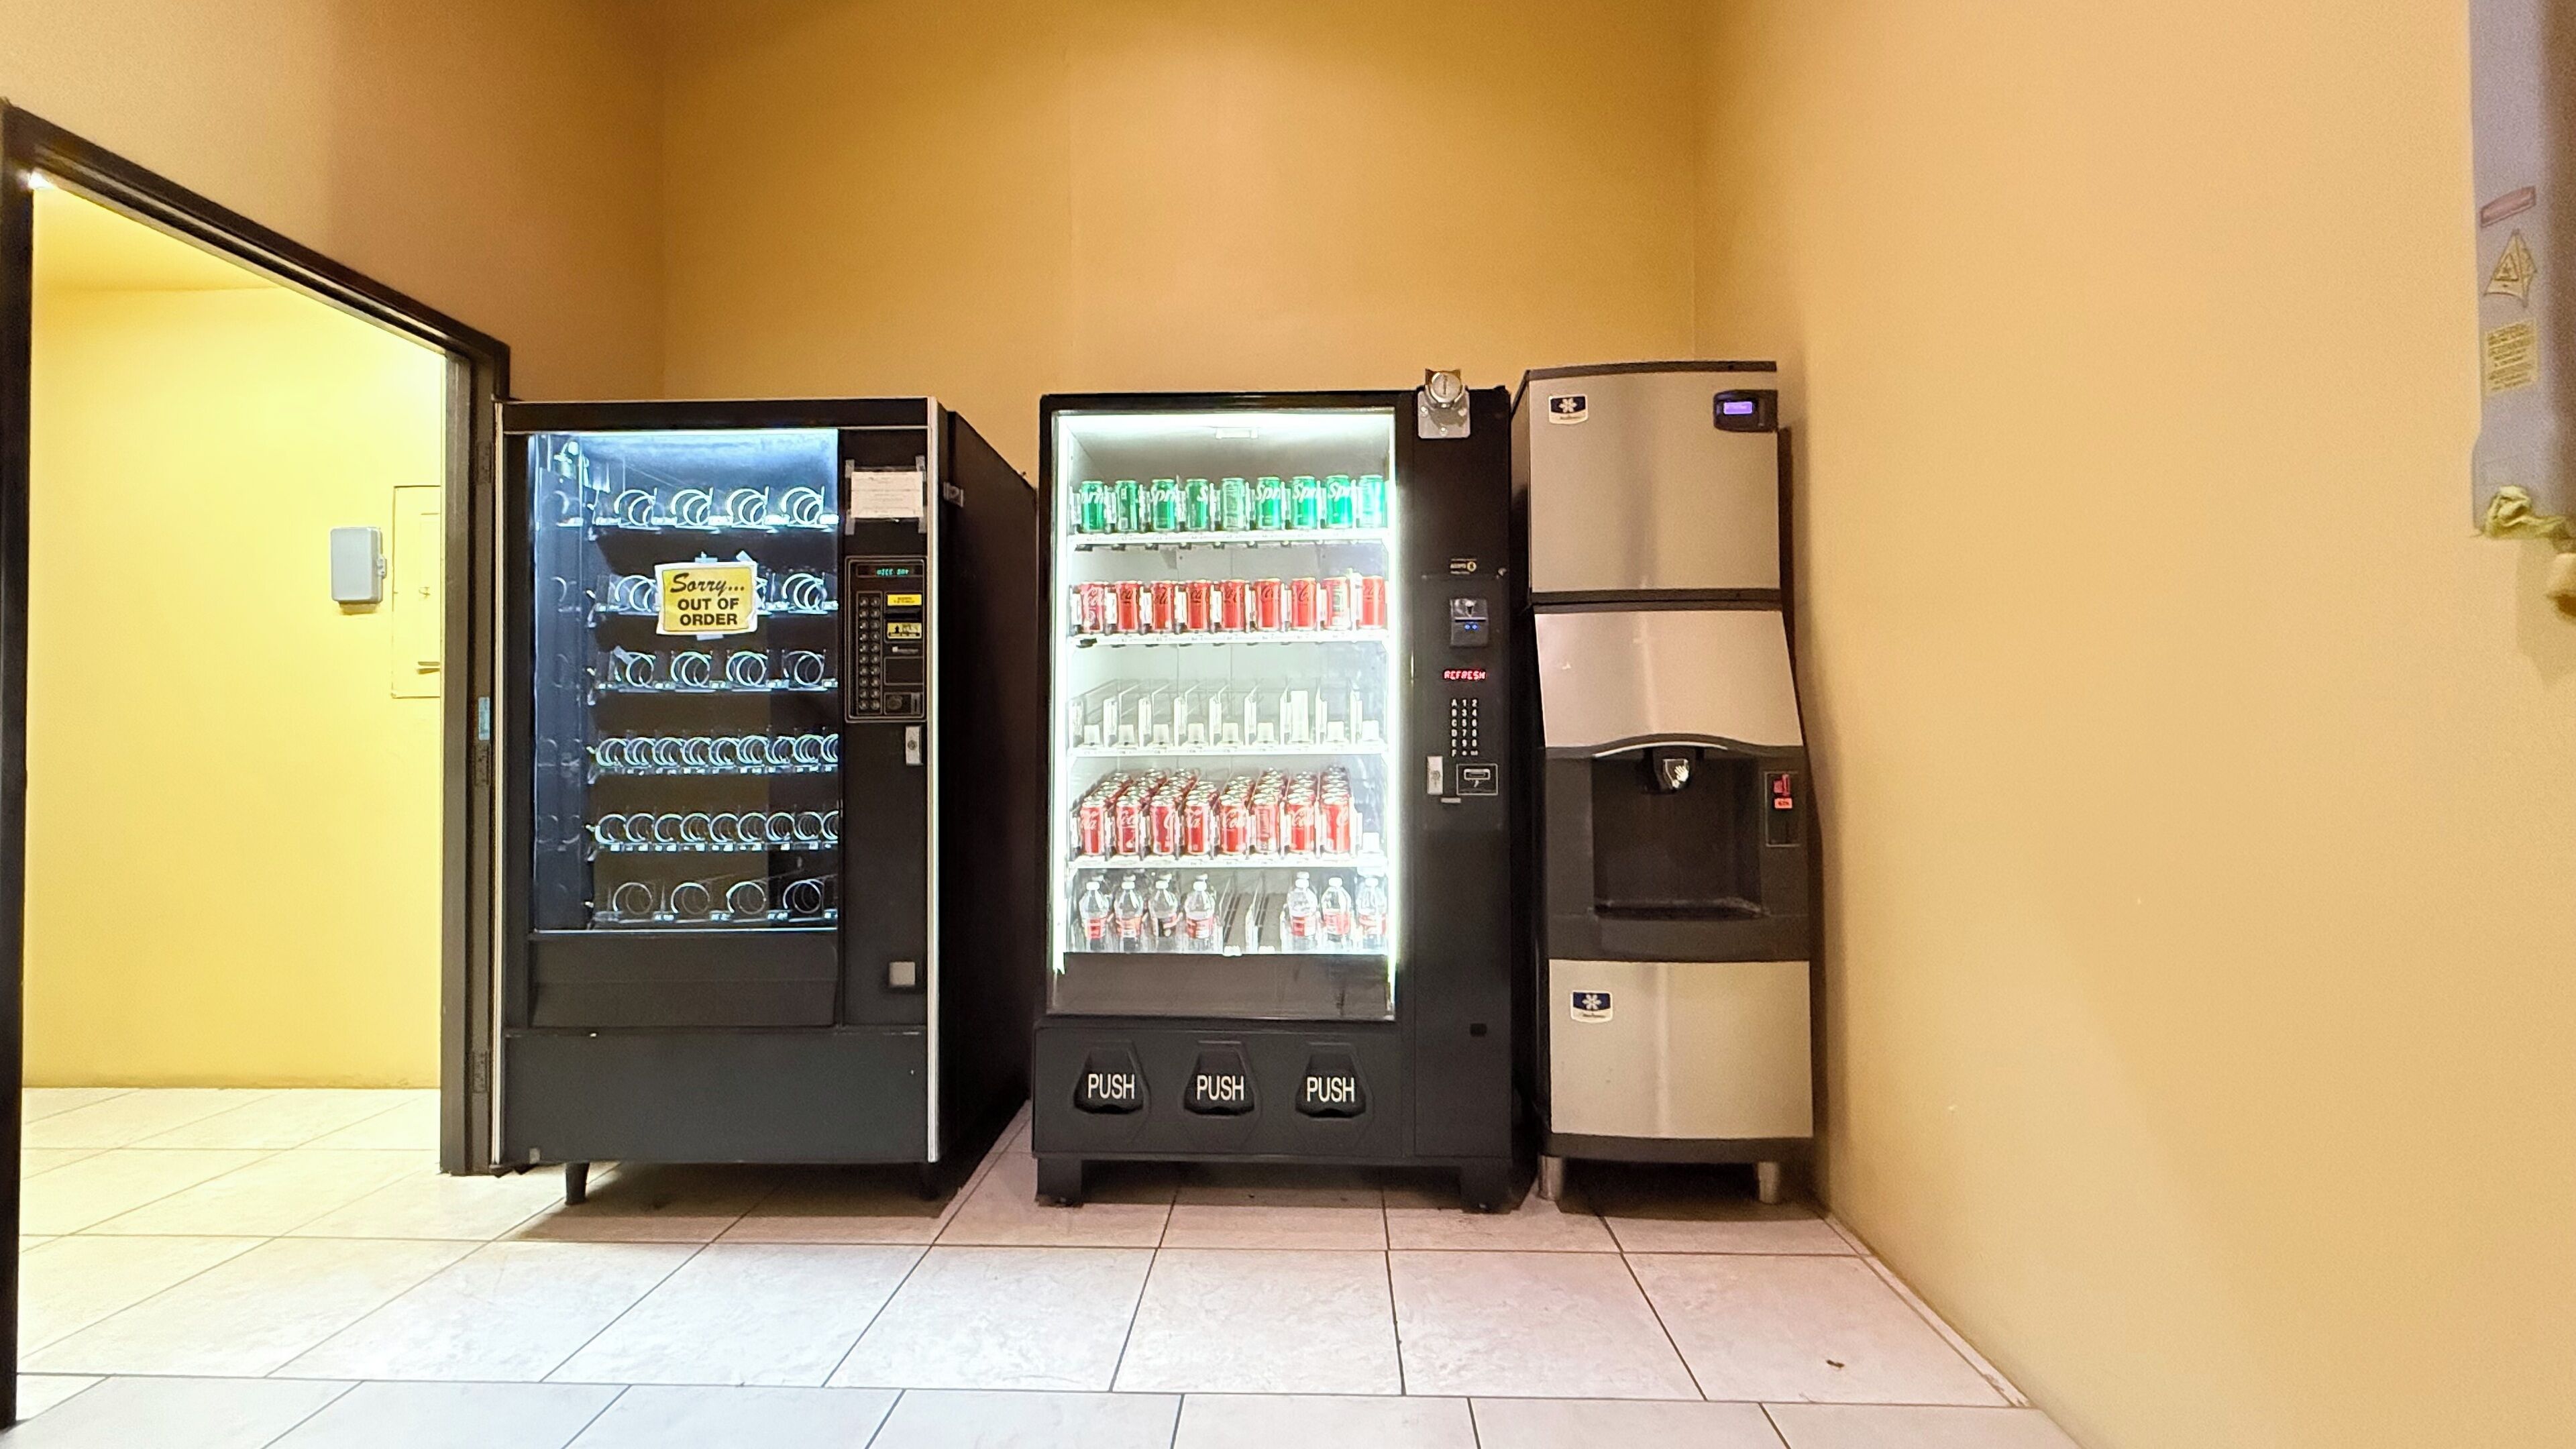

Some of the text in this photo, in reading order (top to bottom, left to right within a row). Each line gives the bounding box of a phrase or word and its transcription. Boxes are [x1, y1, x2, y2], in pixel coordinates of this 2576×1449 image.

[670, 572, 745, 596] Sorry...
[678, 598, 739, 610] OUT OF
[680, 613, 738, 626] ORDER
[1444, 670, 1486, 680] REFRESH
[1451, 699, 1477, 707] A 1 2
[1462, 708, 1467, 717] 3
[1472, 708, 1477, 717] 4
[1451, 718, 1457, 727] C
[1451, 729, 1457, 737] D
[1462, 729, 1467, 737] 7
[1462, 739, 1467, 747] 9
[1451, 749, 1457, 757] F
[1088, 1073, 1135, 1099] PUSH
[1196, 1075, 1244, 1101] PUSH
[1307, 1077, 1355, 1102] PUSH
